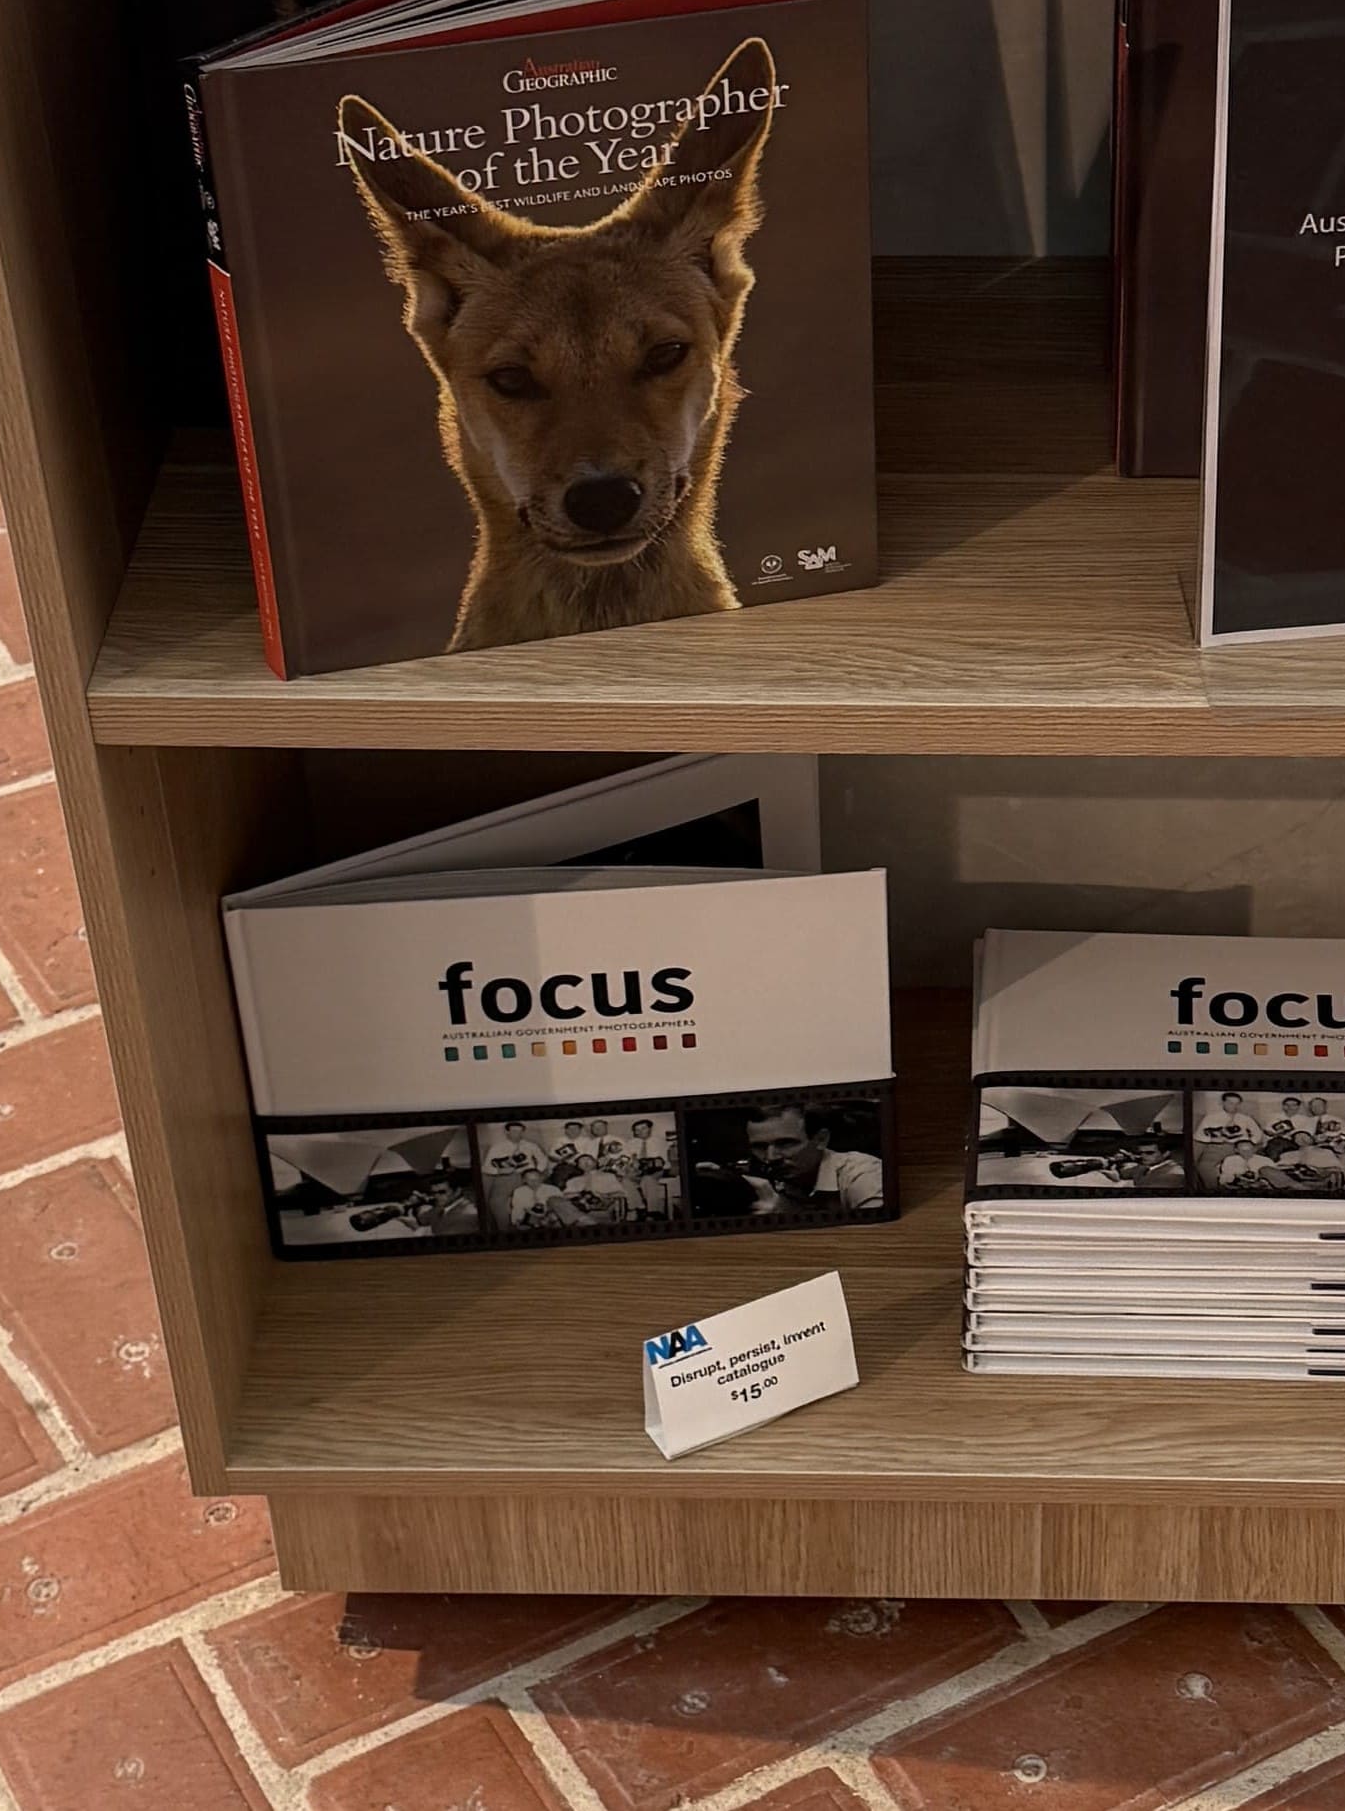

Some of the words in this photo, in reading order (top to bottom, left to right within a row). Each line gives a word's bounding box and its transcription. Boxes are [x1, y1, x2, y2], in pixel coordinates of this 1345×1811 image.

[503, 67, 617, 94] GEOGRAPHIC
[335, 125, 486, 168] Nature
[501, 78, 790, 146] Photographer
[457, 151, 505, 194] of
[513, 142, 579, 185] the
[585, 137, 680, 176] Year
[405, 207, 431, 222] THE
[432, 202, 479, 219] YEAR'S
[513, 189, 572, 207] WILDLIFE
[574, 186, 601, 199] AND
[602, 174, 677, 196] LANDSCAPE
[679, 167, 733, 188] PHOTOS
[438, 960, 695, 1026] focus
[442, 1029, 513, 1040] AUSTRALIAN
[516, 1024, 595, 1037] GOVERNMENT
[597, 1018, 697, 1032] PHOTOGRAPHERS
[1167, 1029, 1236, 1039] AUSTRALIAN
[1239, 1031, 1318, 1040] GOVERNMENT
[644, 1324, 708, 1366] NAA
[729, 1339, 781, 1368] persist,
[783, 1321, 827, 1346] invent
[716, 1353, 786, 1386] catalogue
